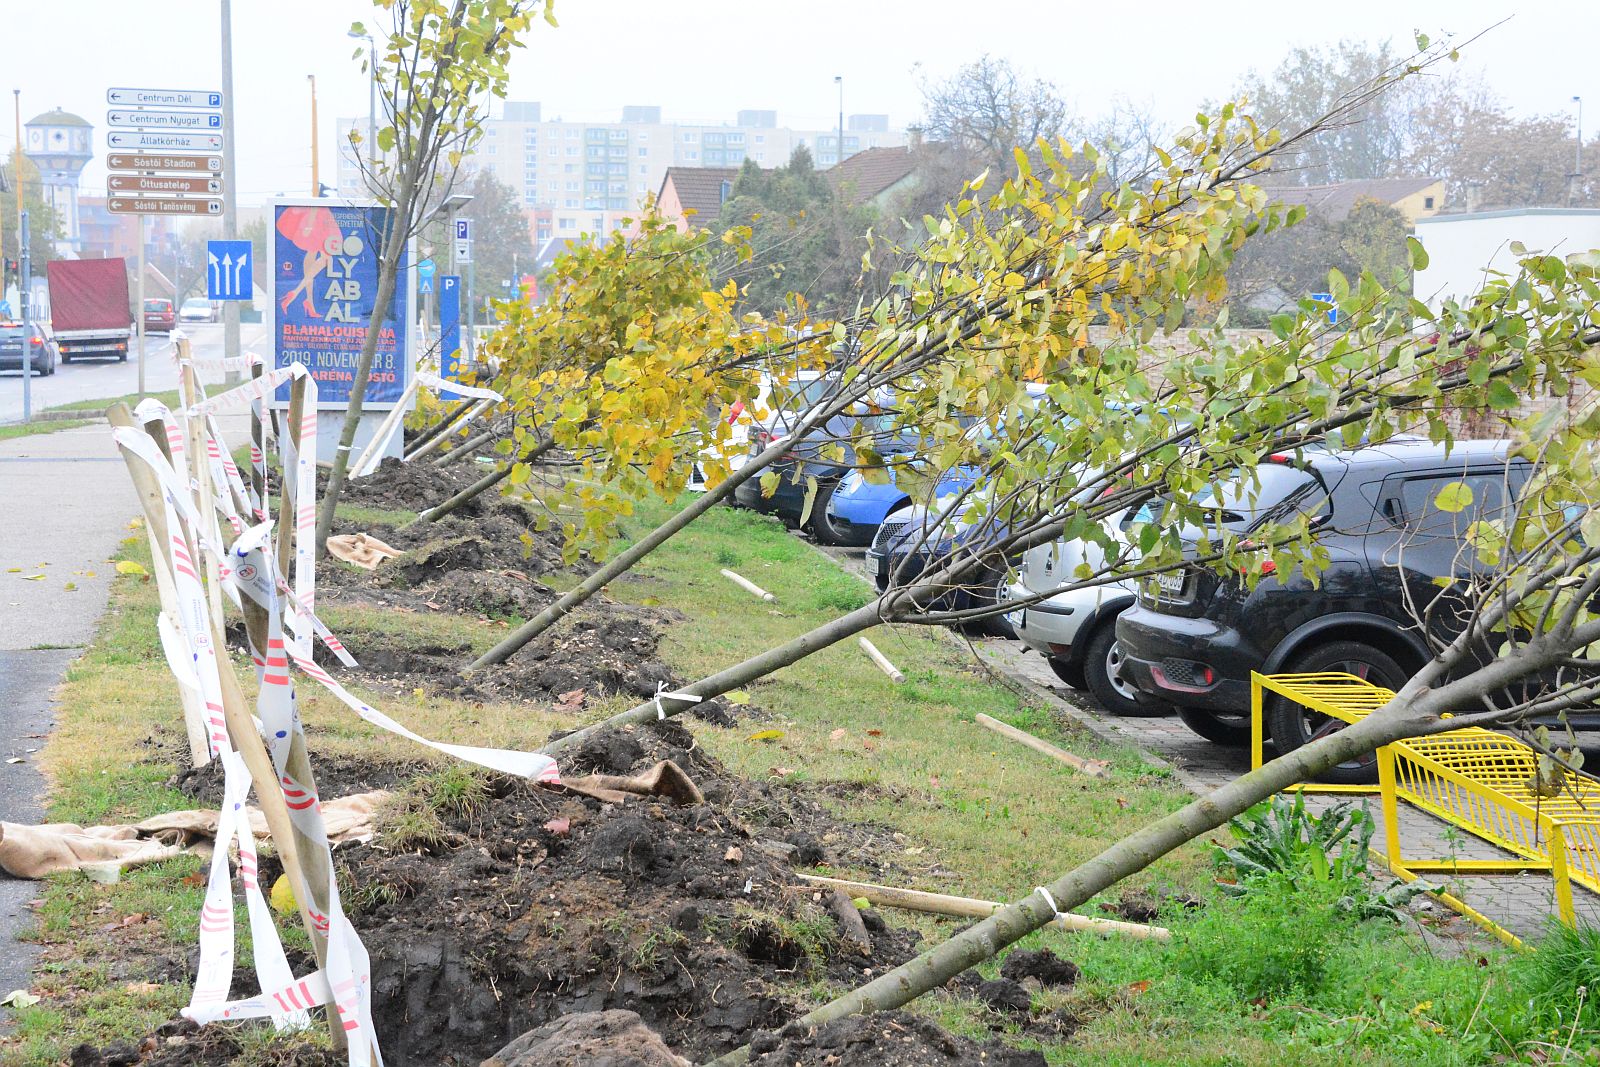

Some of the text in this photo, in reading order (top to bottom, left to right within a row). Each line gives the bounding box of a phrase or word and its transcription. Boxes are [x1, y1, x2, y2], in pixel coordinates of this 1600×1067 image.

[137, 93, 192, 103] Centrum Dél
[210, 96, 218, 105] P
[129, 114, 200, 126] Centrum Nyugat
[210, 117, 218, 126] P
[139, 135, 191, 146] Állatkórház
[134, 158, 196, 168] Sóstói Stadion
[140, 178, 191, 191] Öttusatelep
[134, 201, 196, 213] Sóstói Tanösvény
[458, 223, 465, 237] P
[324, 230, 364, 256] GÓ
[326, 256, 359, 279] LY
[324, 280, 361, 300] AB
[445, 279, 454, 290] P
[324, 297, 360, 323] ÁL
[282, 350, 314, 367] 2019.
[385, 354, 396, 369] 8.
[312, 369, 353, 381] ARÉNA
